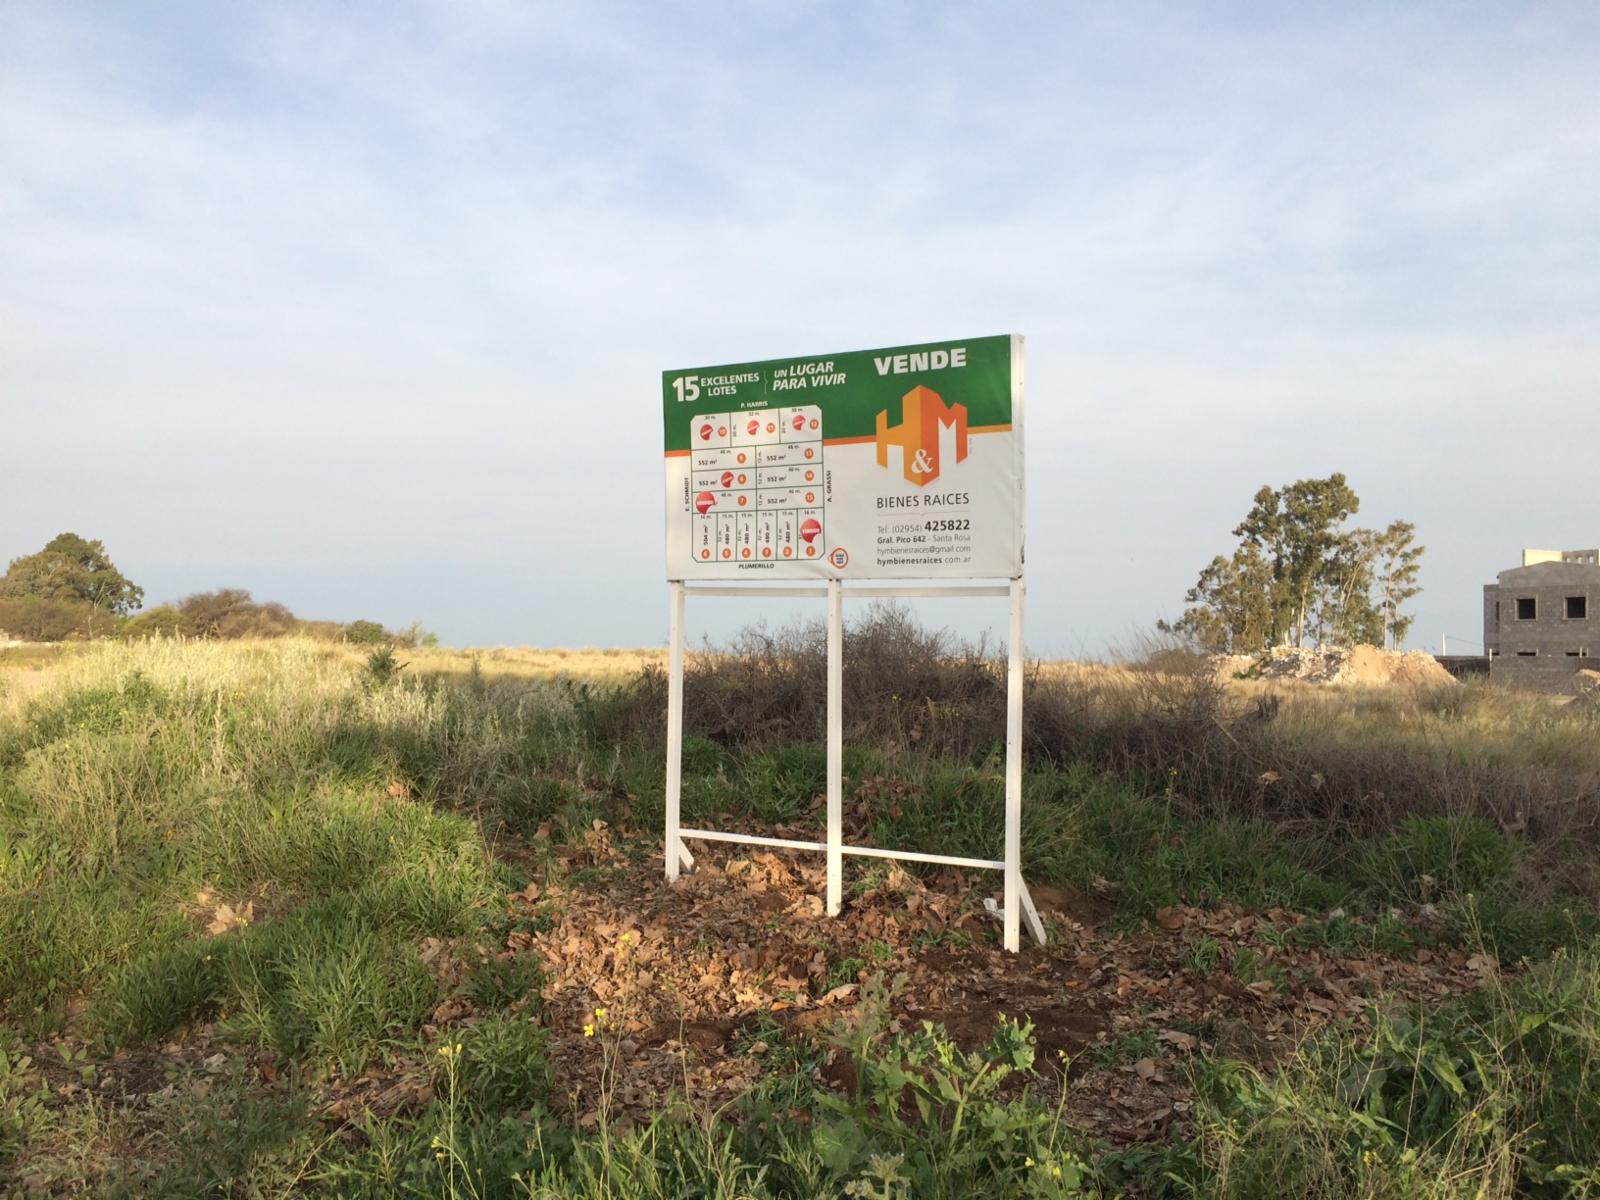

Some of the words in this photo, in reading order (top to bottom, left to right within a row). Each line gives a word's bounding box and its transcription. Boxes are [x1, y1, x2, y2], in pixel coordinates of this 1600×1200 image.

[774, 369, 788, 378] UN
[789, 361, 834, 377] LUGAR
[873, 347, 967, 376] VENDE
[701, 372, 760, 387] EXCELENTES
[772, 377, 807, 391] PARA
[811, 373, 846, 387] VIVIR
[672, 375, 700, 402] 15
[708, 385, 737, 397] LOTES
[876, 496, 919, 508] BIENES
[924, 493, 970, 506] RAICES
[892, 524, 922, 534] (02954)
[925, 519, 970, 532] 425822
